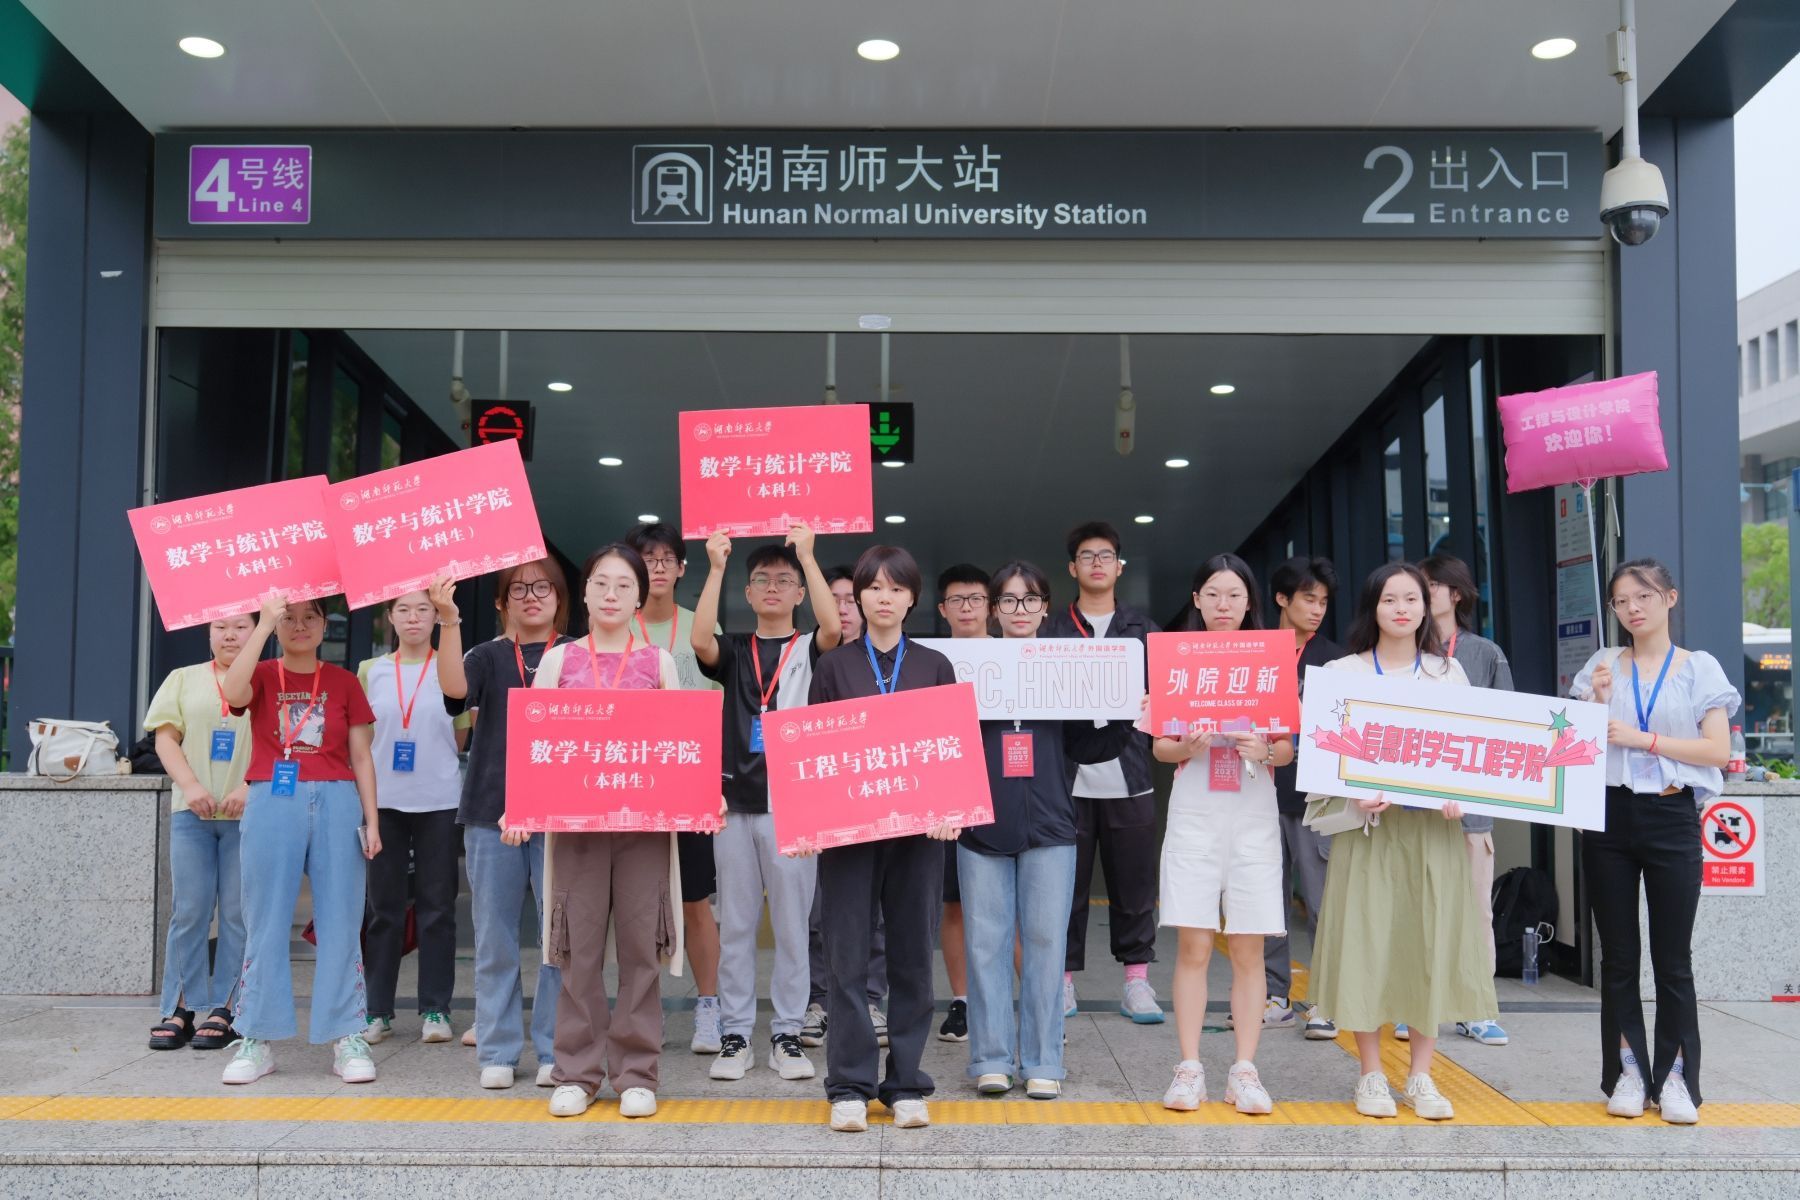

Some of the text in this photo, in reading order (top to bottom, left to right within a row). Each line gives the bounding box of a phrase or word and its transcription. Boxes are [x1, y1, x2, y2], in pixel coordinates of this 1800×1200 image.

[237, 157, 304, 191] 号线
[723, 144, 1003, 193] 湖南师大站
[1362, 145, 1570, 224] 2 出入口
[238, 196, 304, 214] Line 4
[723, 204, 1148, 230] Hunan Normal University Station
[1429, 204, 1570, 224] Entrance
[1520, 398, 1631, 432] 工程与设计学院
[700, 451, 852, 479] 数学与统计学院
[352, 487, 513, 548] 数学与统计学院
[166, 520, 328, 570] 数学与统计学院
[1166, 666, 1280, 696] 外院迎新
[1244, 698, 1259, 706] 2027
[530, 740, 702, 766] 数学与统计学院
[790, 735, 963, 782] 工程与设计学院
[1360, 722, 1547, 783] 信息科学与工程学院
